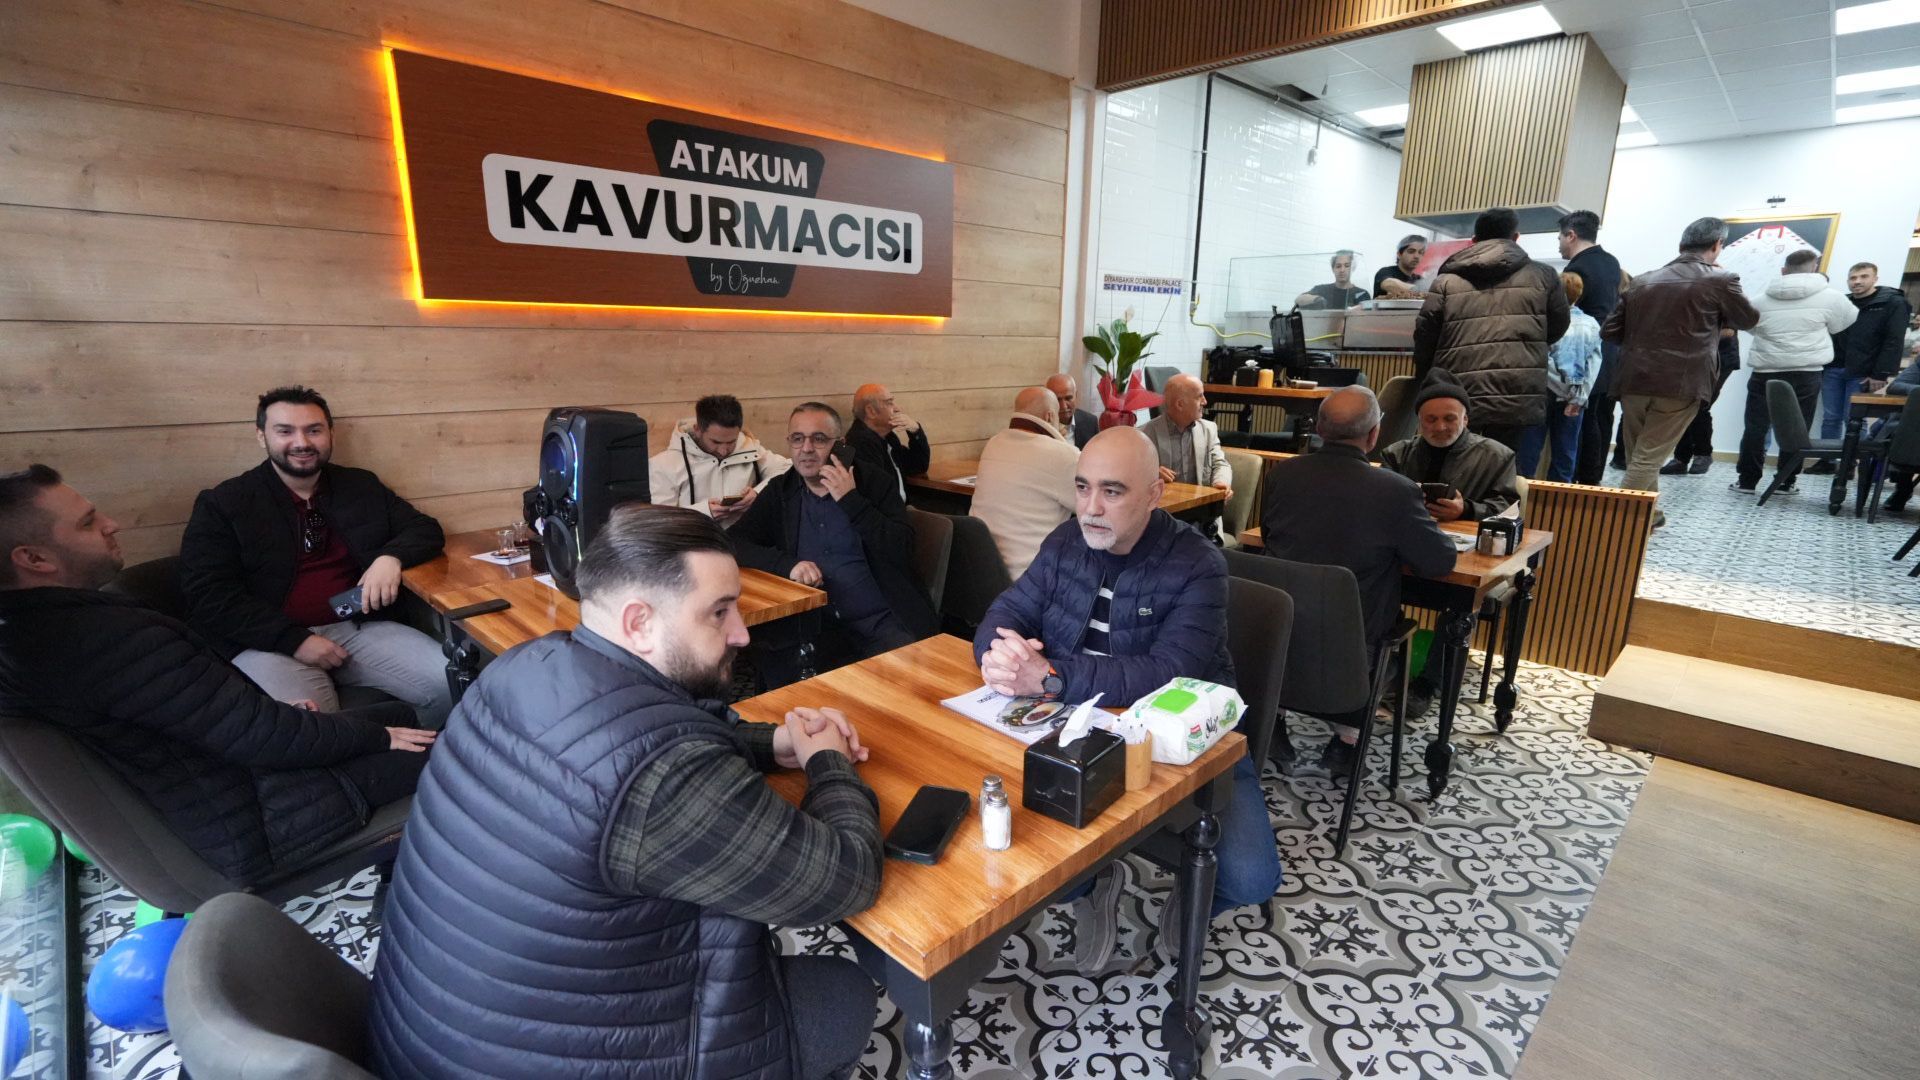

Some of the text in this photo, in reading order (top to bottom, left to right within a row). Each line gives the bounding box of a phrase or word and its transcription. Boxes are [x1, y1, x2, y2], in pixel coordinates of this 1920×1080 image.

[671, 139, 808, 189] ATAKUM
[505, 169, 912, 264] KAVURMACISI
[710, 262, 723, 292] by
[1103, 284, 1181, 295] SEYİTHAN EKİN
[1162, 279, 1181, 287] PALACE
